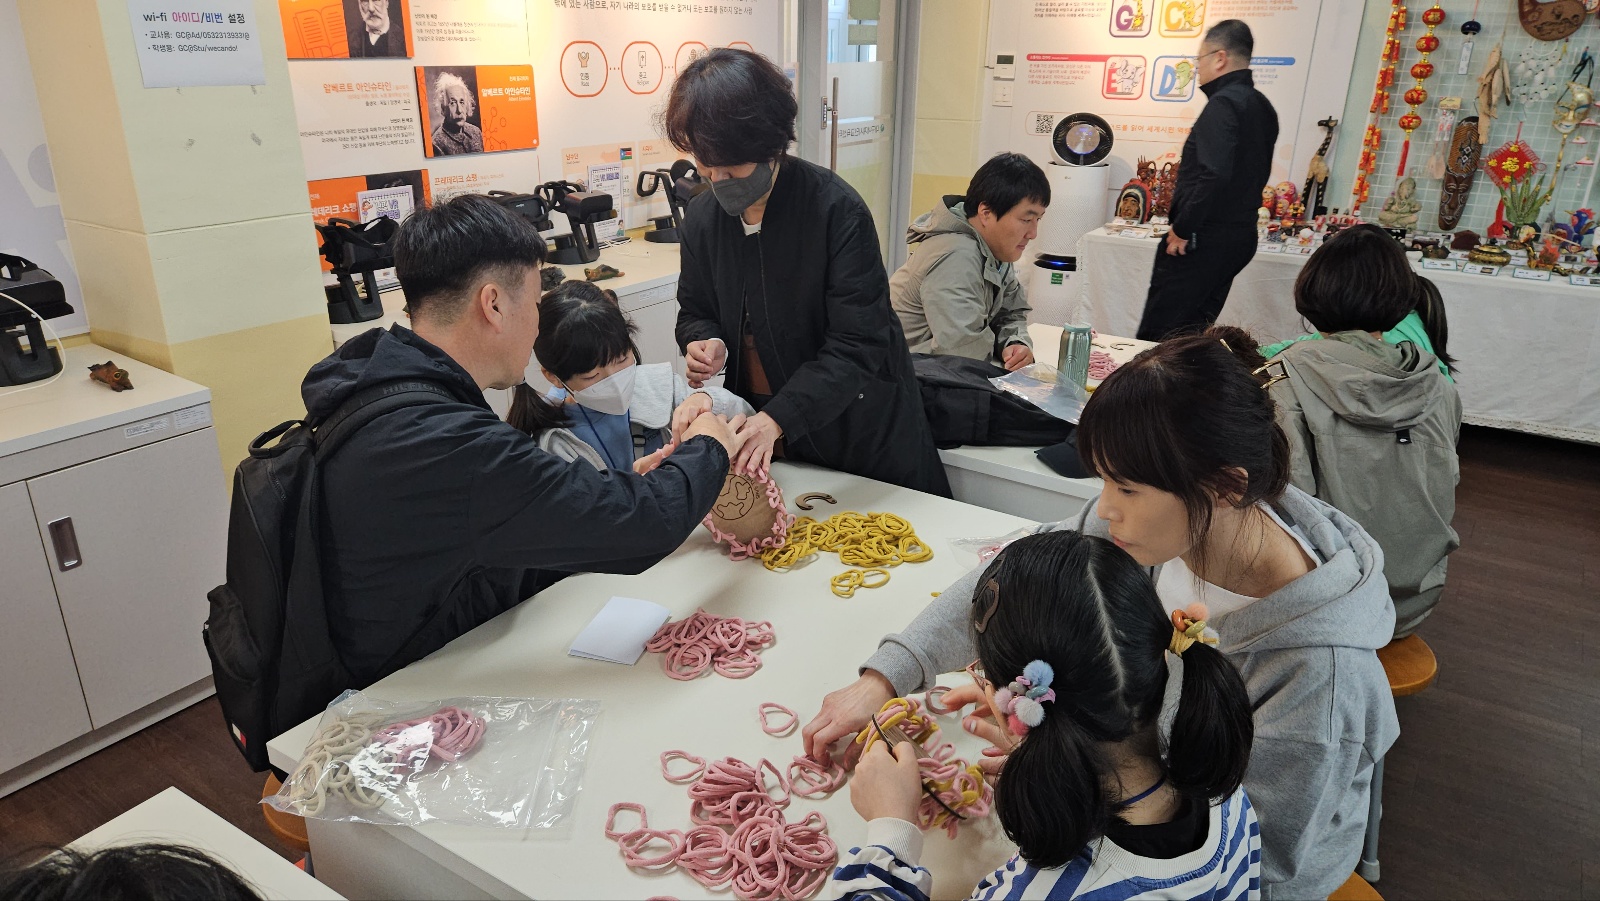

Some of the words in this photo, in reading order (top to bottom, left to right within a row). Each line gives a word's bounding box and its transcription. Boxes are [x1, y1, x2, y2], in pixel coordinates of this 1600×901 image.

[610, 1, 621, 10] 자기
[624, 2, 639, 10] 나라의
[143, 12, 167, 21] wi-fi
[172, 12, 223, 24] 아이디/비번
[228, 13, 245, 24] 설정
[1115, 5, 1133, 30] G
[1165, 2, 1182, 30] C
[1107, 68, 1118, 92] E
[1159, 65, 1176, 96] D
[323, 83, 354, 94] 알베르트
[356, 82, 392, 92] 아인슈타인
[481, 87, 504, 97] 알베르트
[504, 86, 530, 96] 아인슈타인
[1147, 125, 1174, 133] 세계시민
[311, 205, 340, 216] 레데리크
[342, 202, 357, 212] 쇼팽
